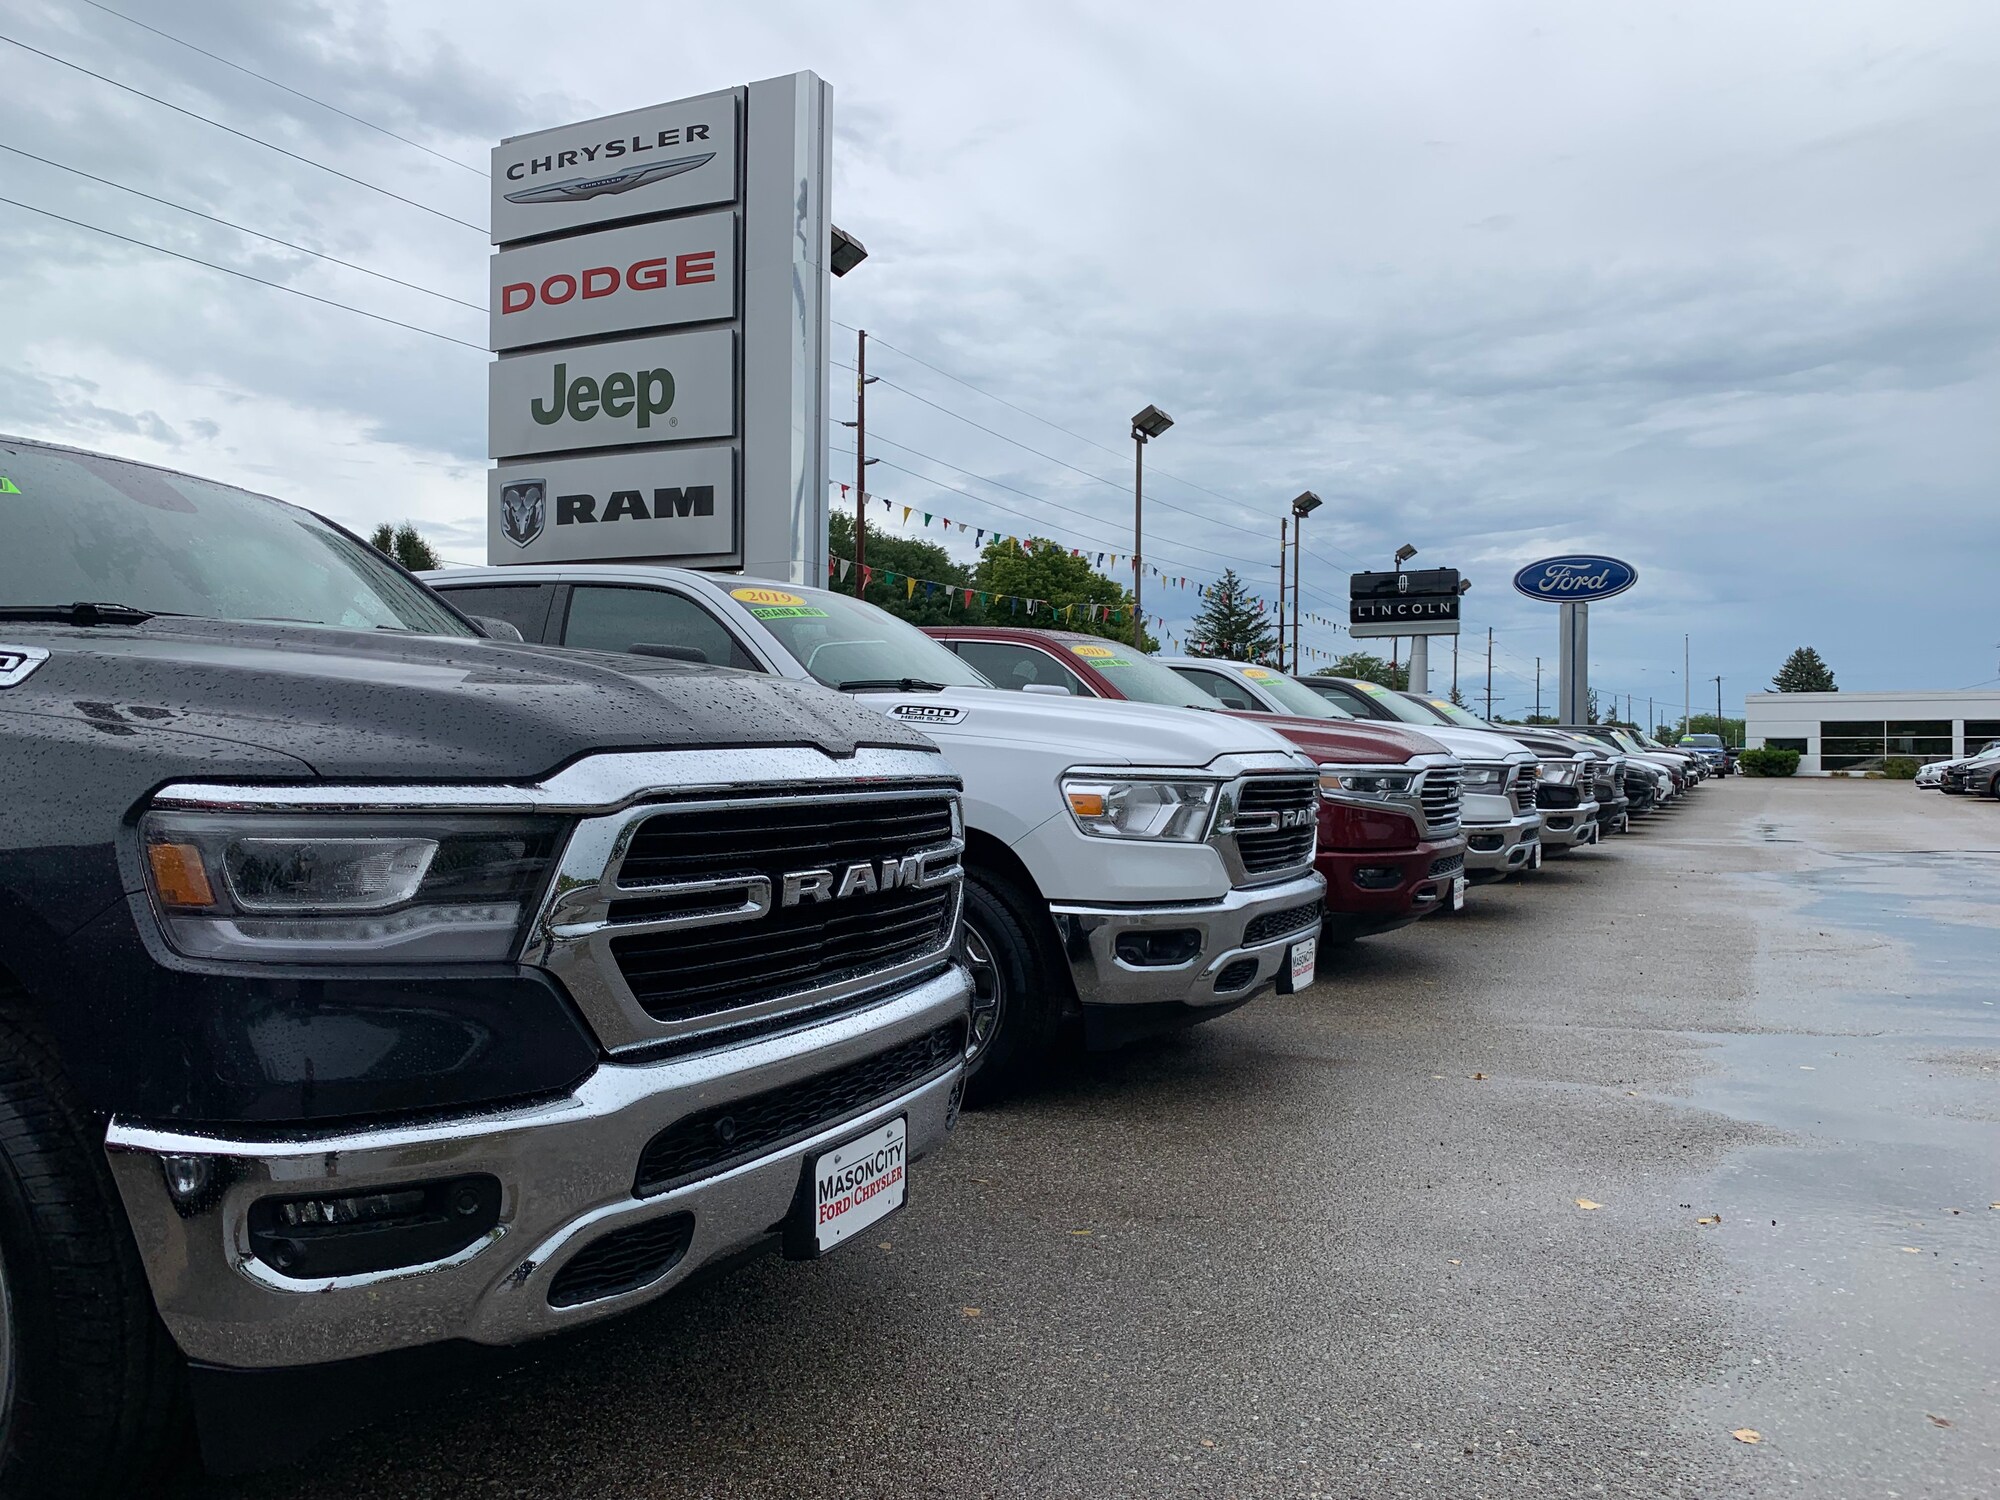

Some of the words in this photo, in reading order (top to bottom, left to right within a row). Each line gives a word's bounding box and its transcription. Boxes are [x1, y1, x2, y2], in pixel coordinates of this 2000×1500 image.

[506, 124, 710, 180] CHRYSLER
[502, 251, 716, 315] DODGE
[531, 363, 675, 429] Jeep
[556, 485, 714, 525] RAM
[1538, 563, 1610, 592] Ford
[746, 591, 792, 603] 2019
[754, 607, 796, 618] BRAND
[1358, 602, 1450, 616] LINCOLN
[901, 706, 956, 717] 1500
[782, 855, 918, 907] RAM
